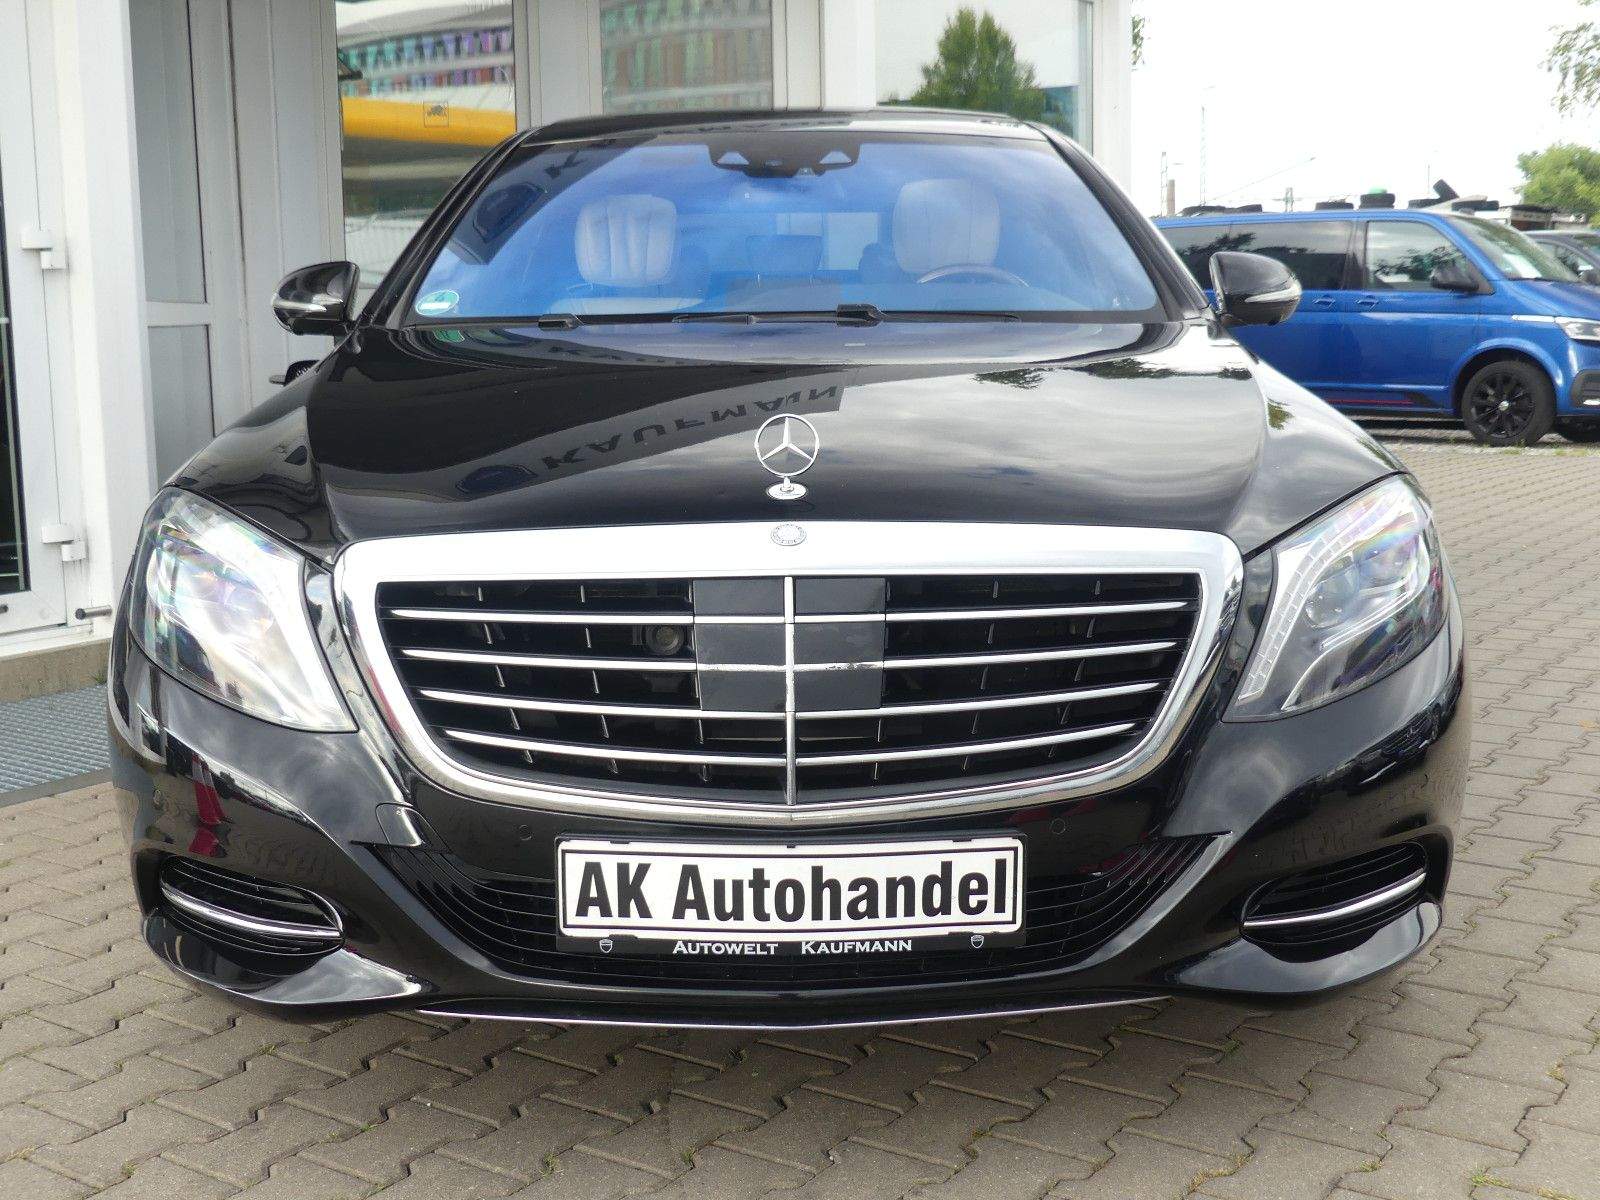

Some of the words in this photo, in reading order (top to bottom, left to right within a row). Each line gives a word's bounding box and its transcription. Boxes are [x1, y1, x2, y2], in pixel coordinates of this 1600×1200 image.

[575, 861, 653, 919] AK
[672, 857, 1007, 922] Autohandel
[672, 939, 779, 955] AUTOWELT
[801, 938, 914, 955] KAUFMANN
